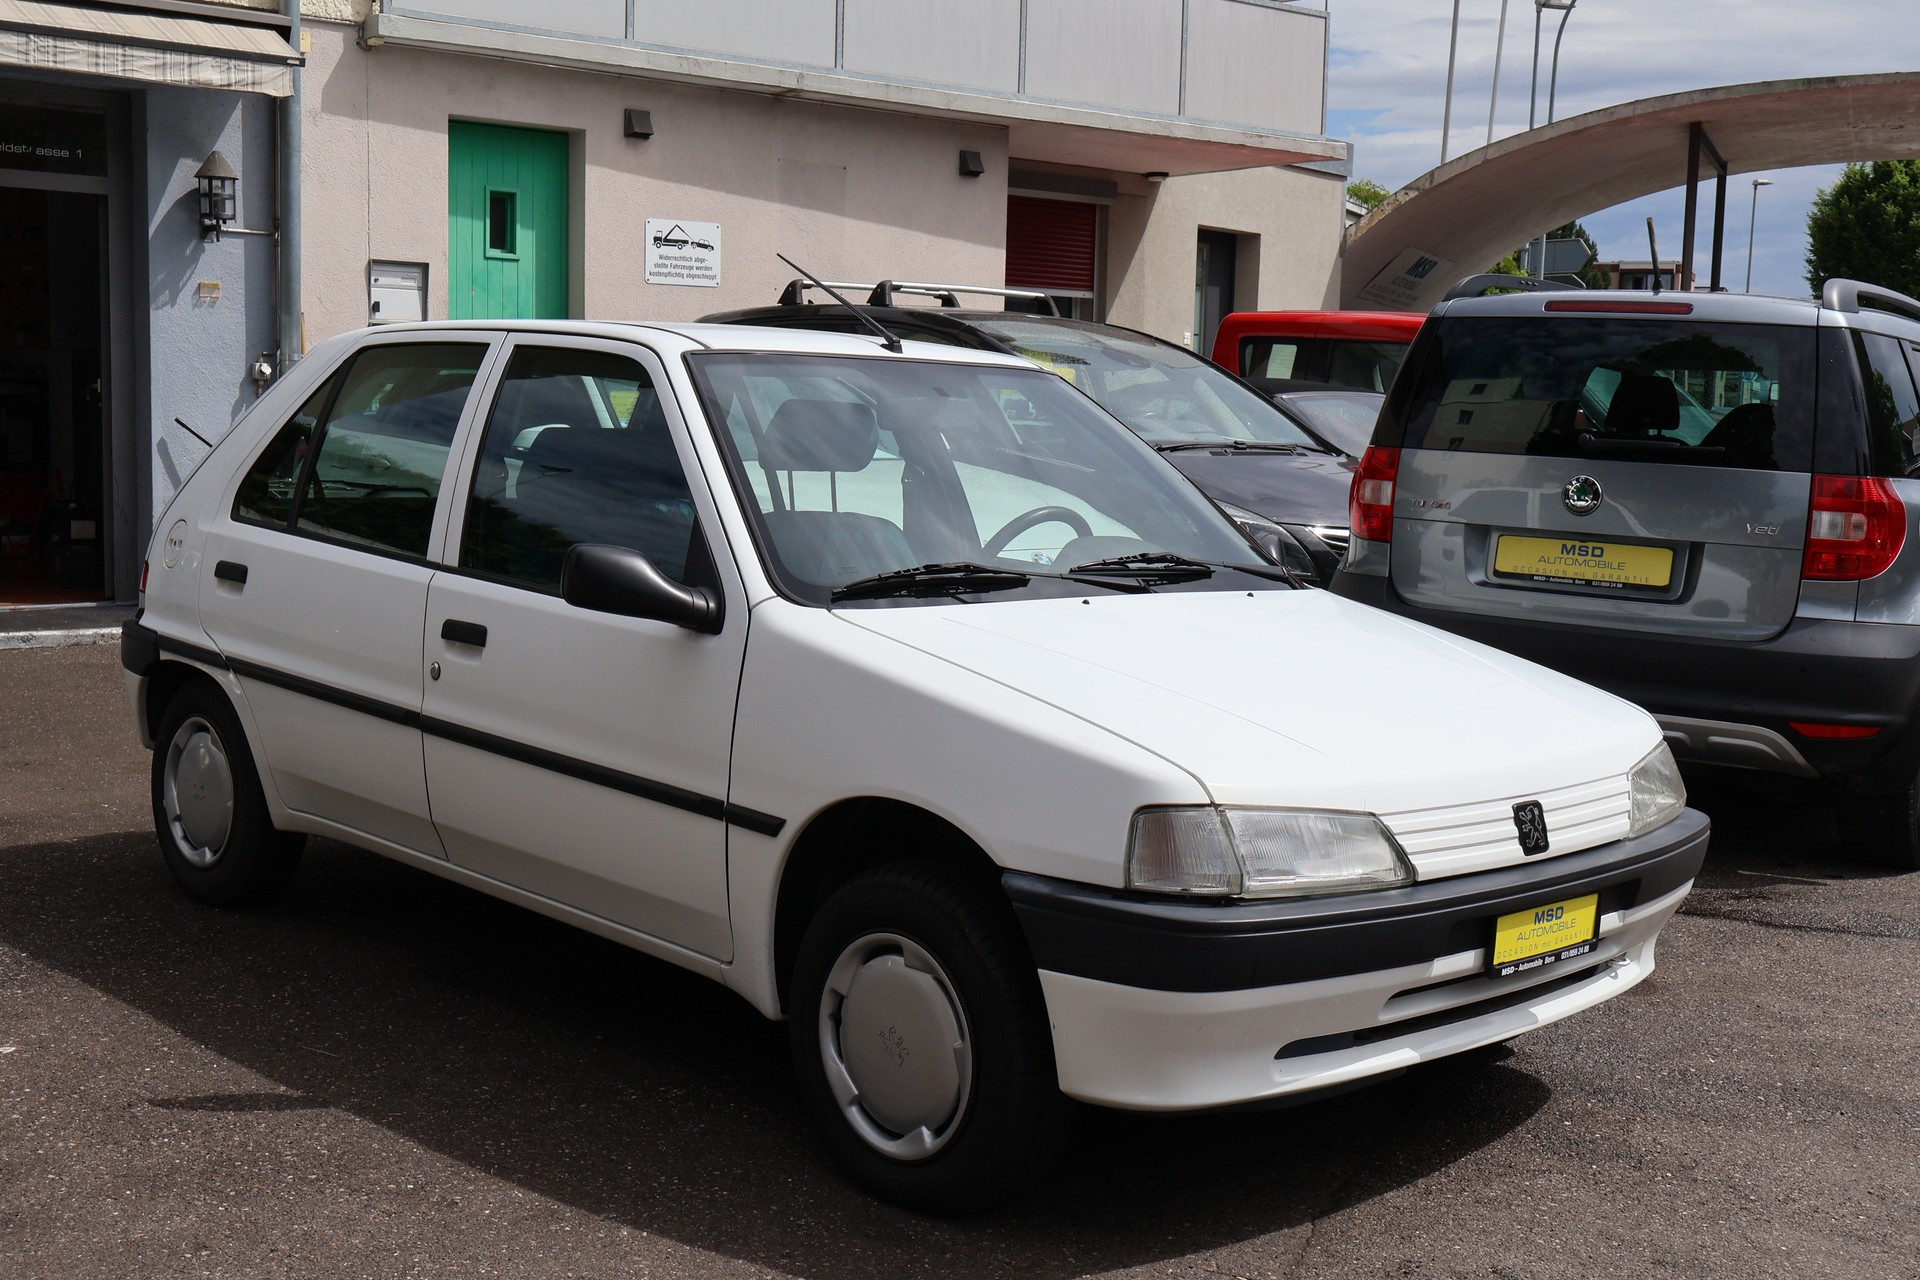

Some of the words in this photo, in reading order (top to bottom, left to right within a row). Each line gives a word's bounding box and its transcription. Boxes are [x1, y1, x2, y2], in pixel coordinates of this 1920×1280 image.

[76, 149, 82, 159] 1
[654, 262, 669, 270] stellte
[670, 262, 694, 272] Fahrzeuge
[659, 254, 693, 262] Widerrechtlich
[694, 256, 708, 264] abge-
[649, 270, 684, 279] kostenpflichtig
[1561, 543, 1605, 558] MSD
[1538, 555, 1626, 571] AUTOMOBILE
[1512, 565, 1568, 576] OCCASION
[1592, 571, 1651, 584] GARANTIE
[1534, 905, 1564, 926] MSD
[1516, 918, 1576, 942] AUTOMOBILE
[1497, 942, 1539, 960] OCCASION
[1554, 928, 1590, 945] GARANTIE
[1518, 958, 1543, 972] Automobile
[1544, 955, 1556, 965] Bern
